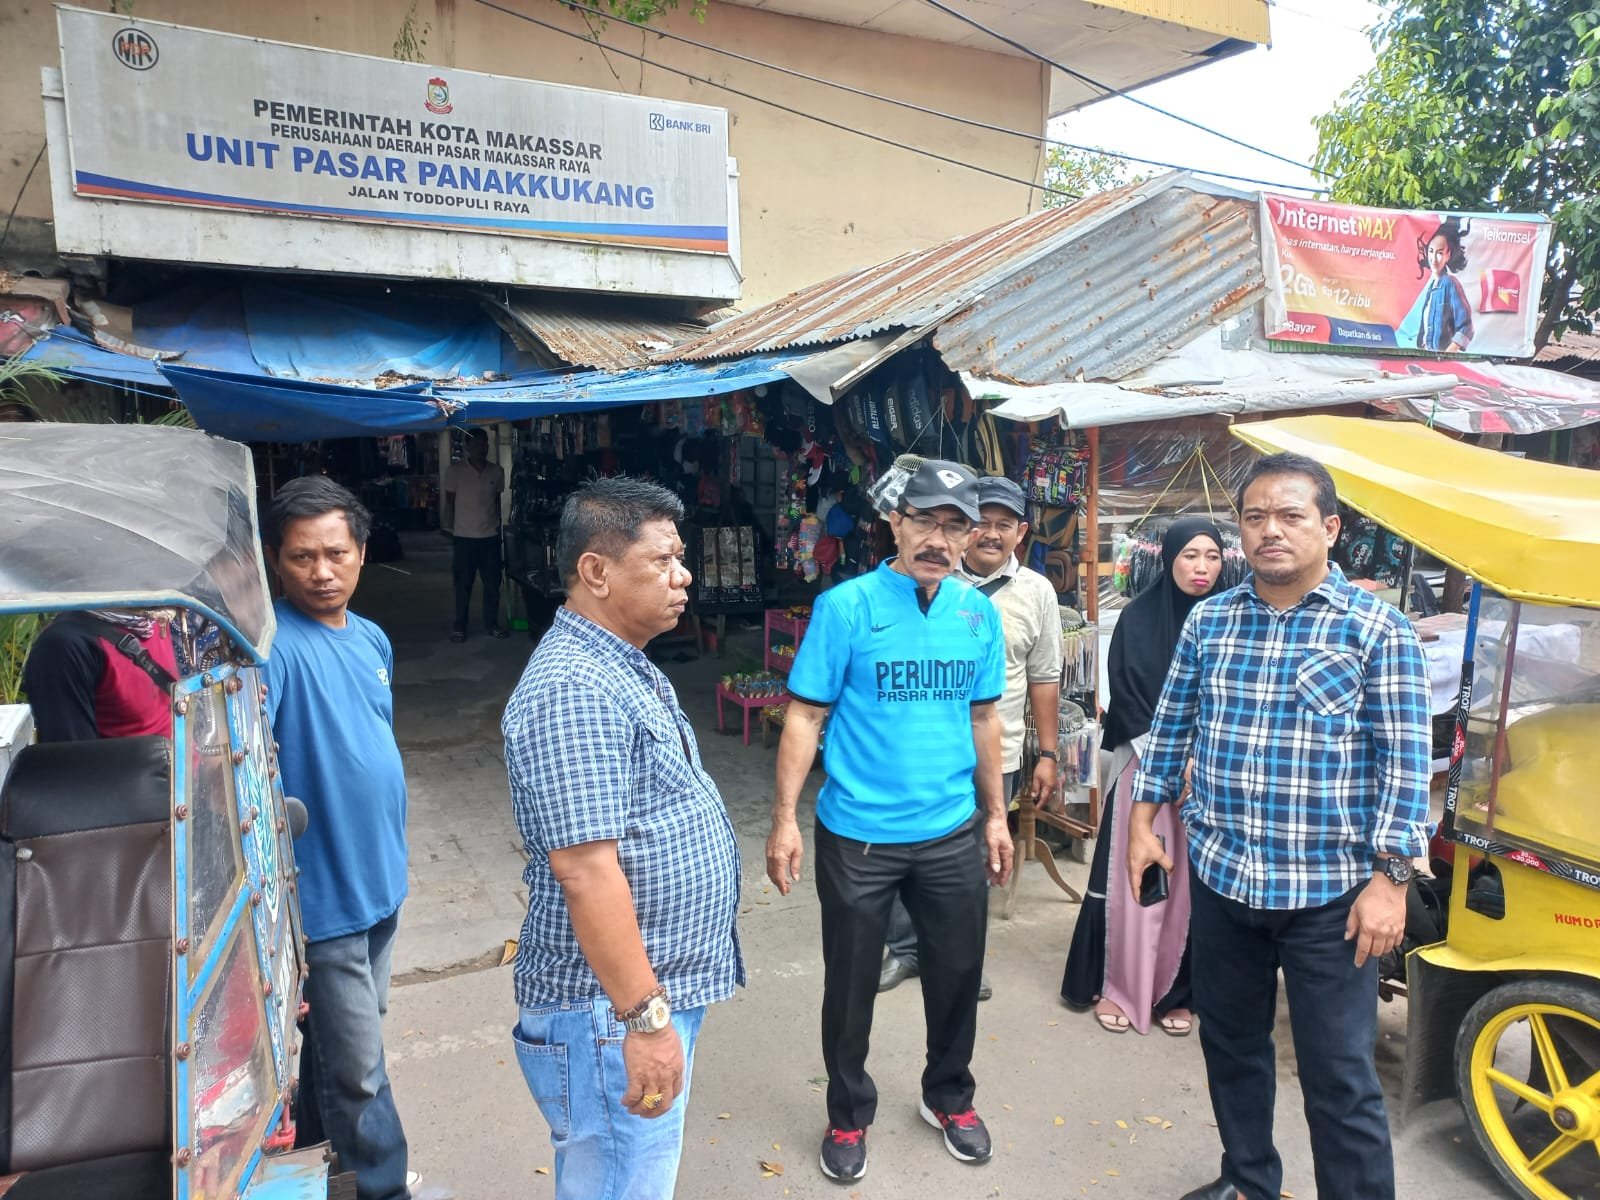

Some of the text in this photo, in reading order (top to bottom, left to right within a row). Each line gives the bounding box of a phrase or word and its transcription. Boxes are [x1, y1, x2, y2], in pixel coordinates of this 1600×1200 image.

[253, 99, 602, 160] PEMERINTAH KOTA MAKASSAR
[665, 119, 711, 134] BANK BRI
[271, 123, 591, 174] PERUSAHAAN DAERAH PASAR MAKASSAR RAYA
[186, 133, 654, 210] UNIT PASAR PANAKKUKANG
[348, 185, 530, 214] JALAN TODDOPULI RAYA
[1277, 202, 1396, 241] InternetMAX
[1482, 226, 1531, 244] Telkomsel
[1288, 320, 1317, 335] Bayar
[1338, 326, 1365, 339] Dapatkan
[887, 397, 898, 432] EIGER
[875, 659, 975, 690] PERUMDA
[877, 690, 928, 702] PASAR
[1461, 684, 1471, 712] TROY
[1446, 786, 1458, 813] TROY
[1463, 833, 1490, 849] TROY
[1574, 869, 1600, 888] TRO
